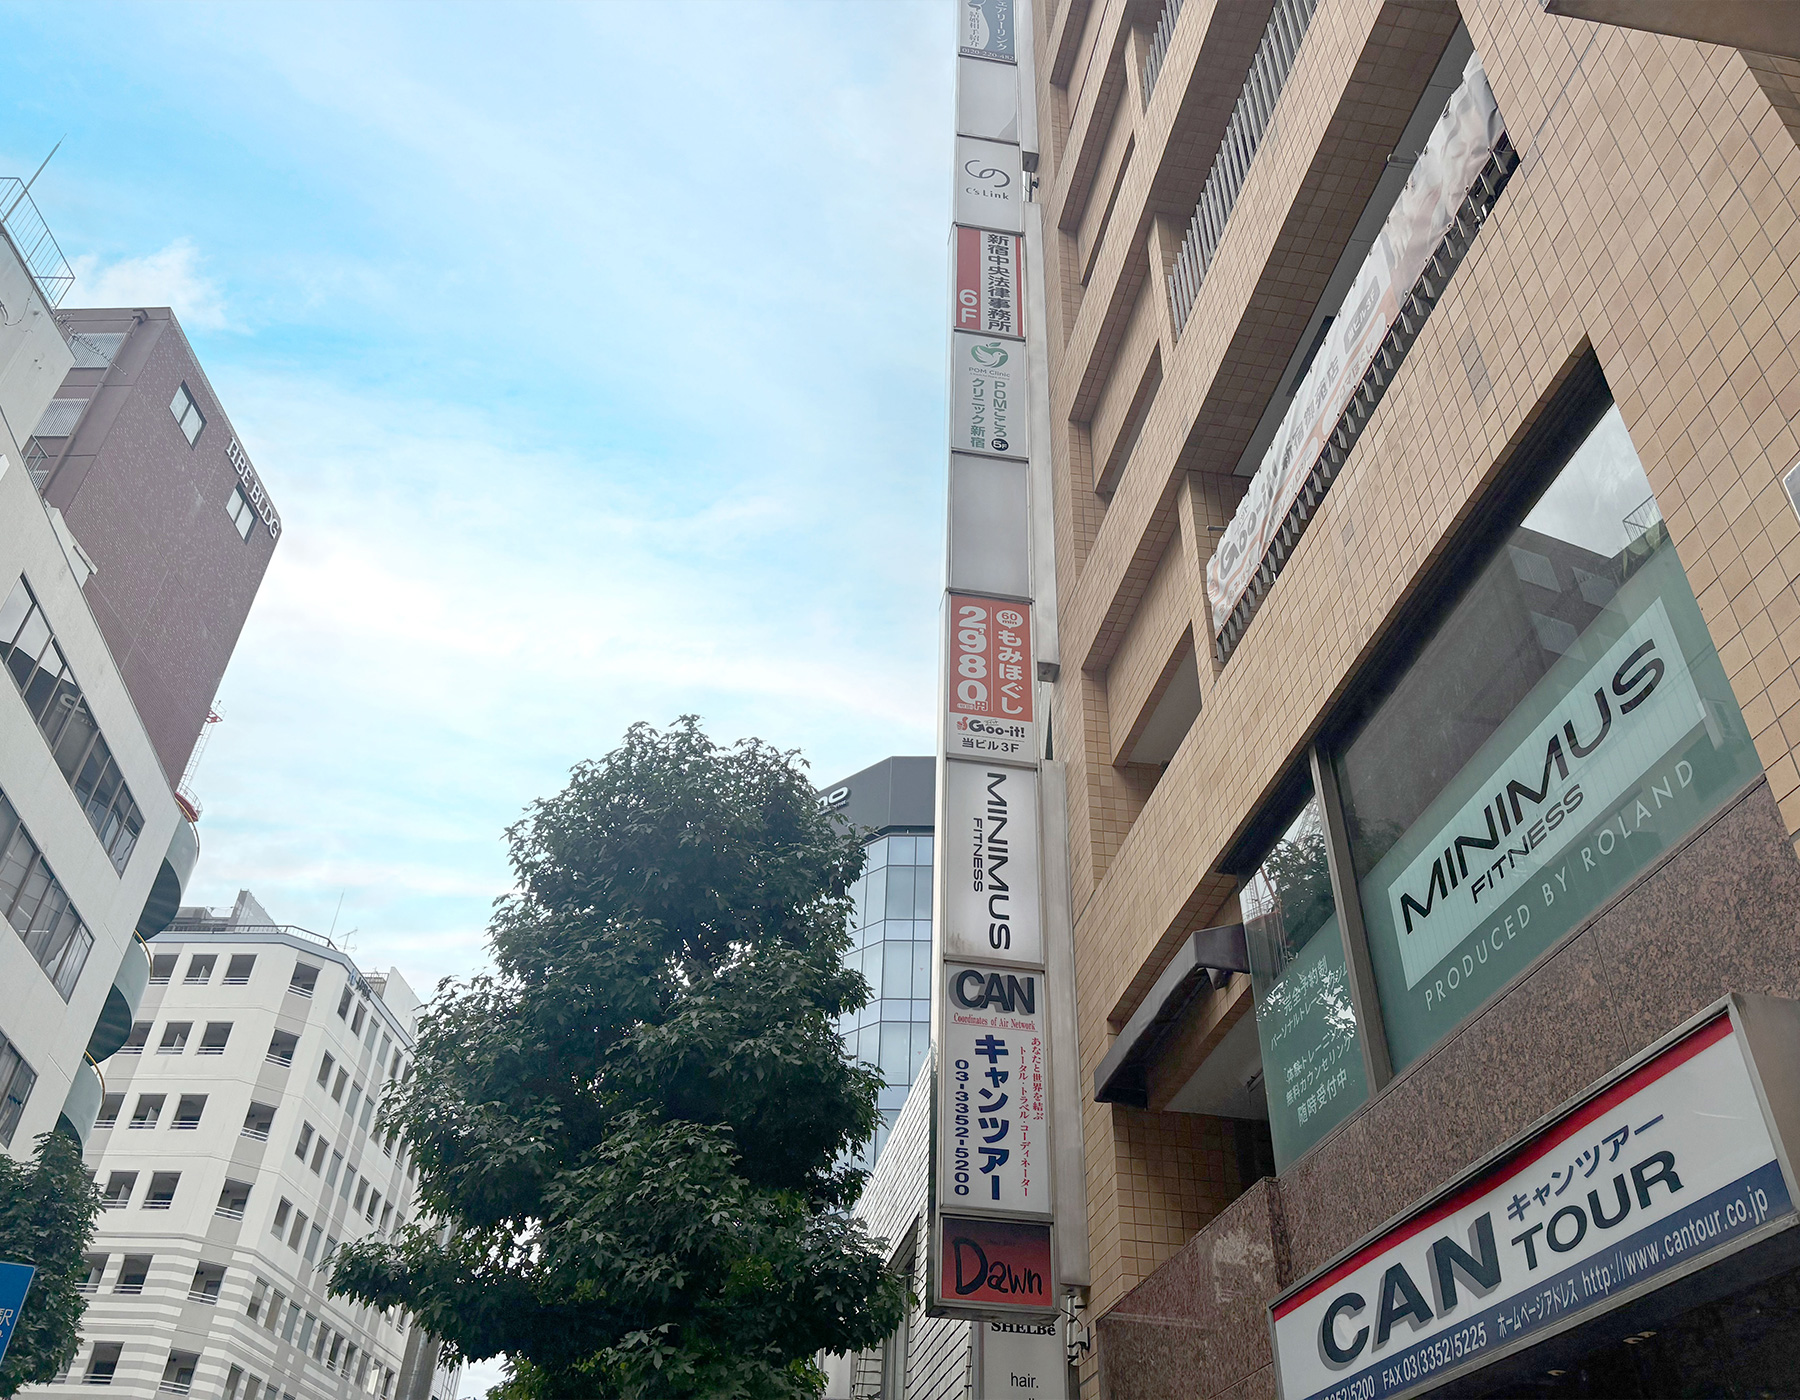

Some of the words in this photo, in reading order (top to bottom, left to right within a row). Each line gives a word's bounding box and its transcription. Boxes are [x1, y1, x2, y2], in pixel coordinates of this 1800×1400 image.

[982, 189, 1009, 200] Link
[959, 288, 977, 324] 6F
[987, 233, 1011, 333] 新宿中央法律事務所
[989, 370, 1011, 378] Clinic
[993, 380, 1007, 438] POMこころ
[971, 377, 985, 448] クリニック新宿
[1281, 356, 1340, 471] 新宿御苑店
[248, 482, 282, 540] BLDG
[1001, 611, 1018, 621] 60
[998, 629, 1023, 715] もみほぐし
[961, 737, 1020, 753] 当ビル3F
[968, 718, 1025, 738] Goo-it!
[1400, 638, 1665, 936] MINIMUS
[973, 817, 983, 892] FITNESS
[987, 772, 1011, 951] MINIMUS
[1470, 784, 1584, 905] FITNESS
[1424, 903, 1531, 1012] PRODUCED
[1540, 866, 1570, 908] BY
[1583, 760, 1695, 872] ROLAND
[949, 969, 1036, 1016] CAN
[953, 1011, 988, 1026] Coordinates
[990, 1016, 998, 1027] of
[999, 1017, 1009, 1028] Air
[1011, 1018, 1036, 1031] Network
[1282, 955, 1329, 1017] 完全予約制
[1031, 1037, 1044, 1121] あなたと世界を結ぶ
[1286, 1035, 1351, 1107] 無料カウンセリング
[1297, 1068, 1347, 1127] 随時受付中
[954, 1059, 970, 1196] 03-3352-5200
[974, 1034, 1010, 1201] キャンツアー
[1506, 1113, 1665, 1222] キャンツアー
[1511, 1149, 1684, 1272] TOUR
[952, 1236, 1042, 1295] Dawn
[1317, 1211, 1502, 1372] CAN
[1382, 1359, 1403, 1390] FAX
[1402, 1321, 1487, 1382] 03(3352)5225
[1497, 1278, 1579, 1338] ホームページアドレス
[1581, 1185, 1769, 1295] http://www.cantour.co.jp
[1010, 1372, 1039, 1388] hair.
